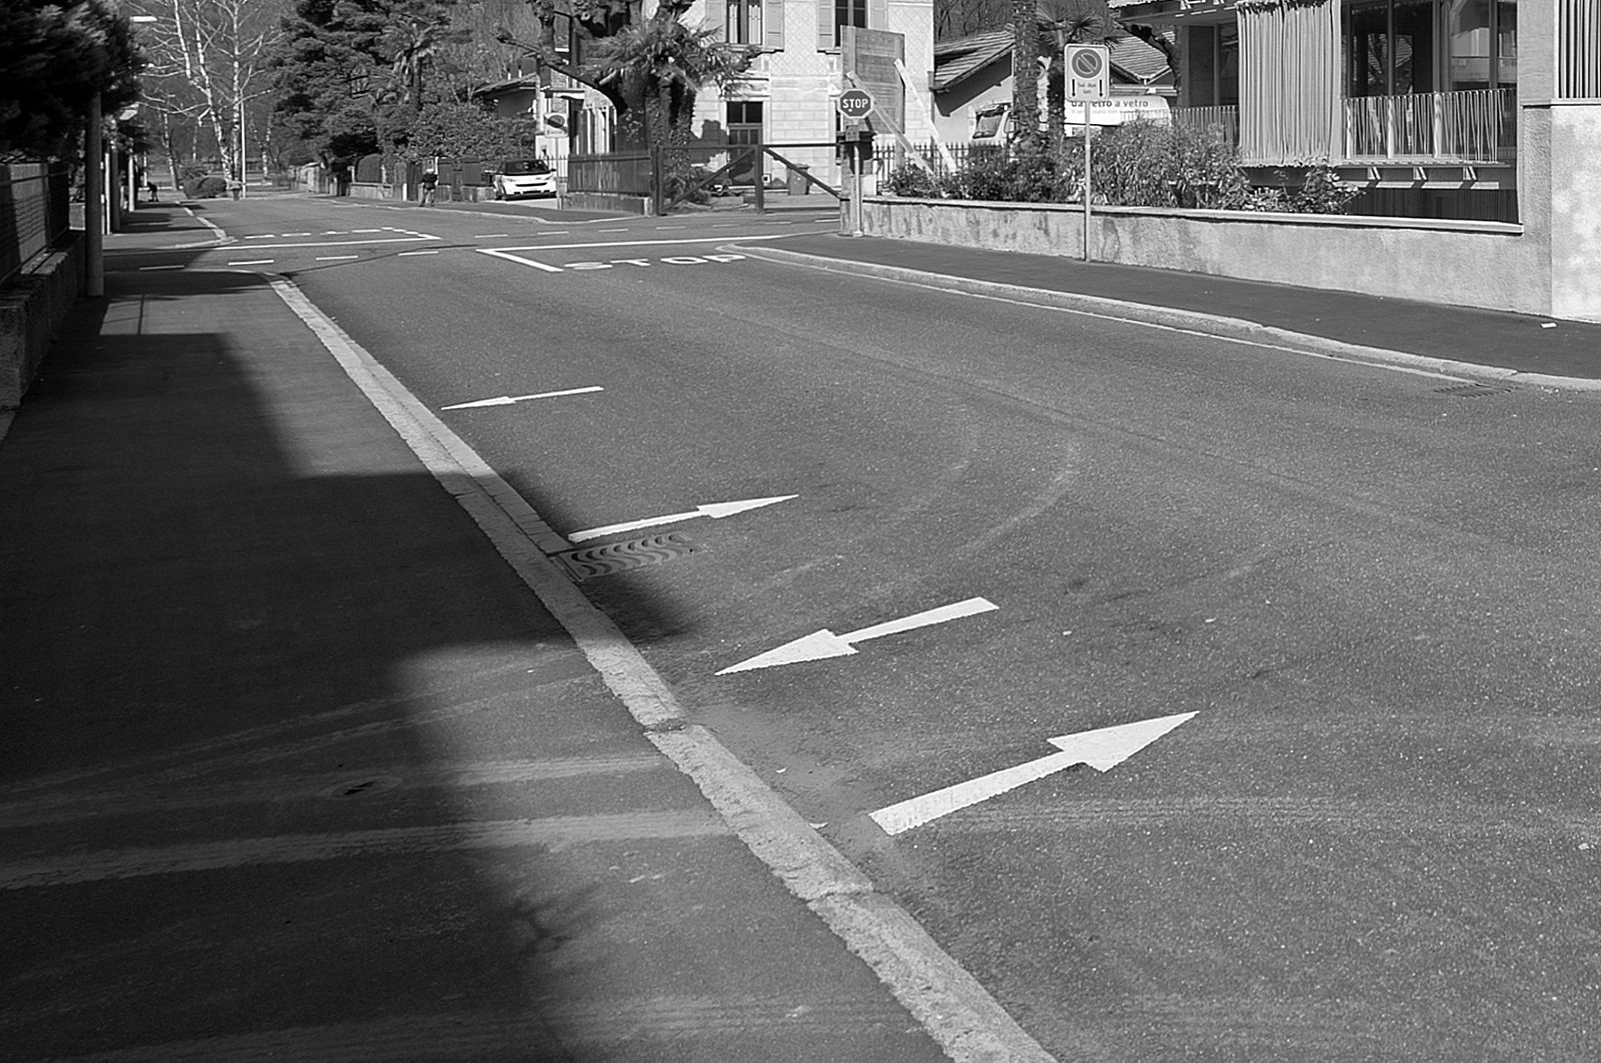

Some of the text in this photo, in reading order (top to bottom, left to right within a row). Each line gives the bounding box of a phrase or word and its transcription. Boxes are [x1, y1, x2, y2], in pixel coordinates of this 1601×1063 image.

[842, 98, 869, 109] STOP
[1115, 100, 1122, 108] a
[1123, 98, 1149, 108] vetro
[564, 254, 747, 271] STOP
